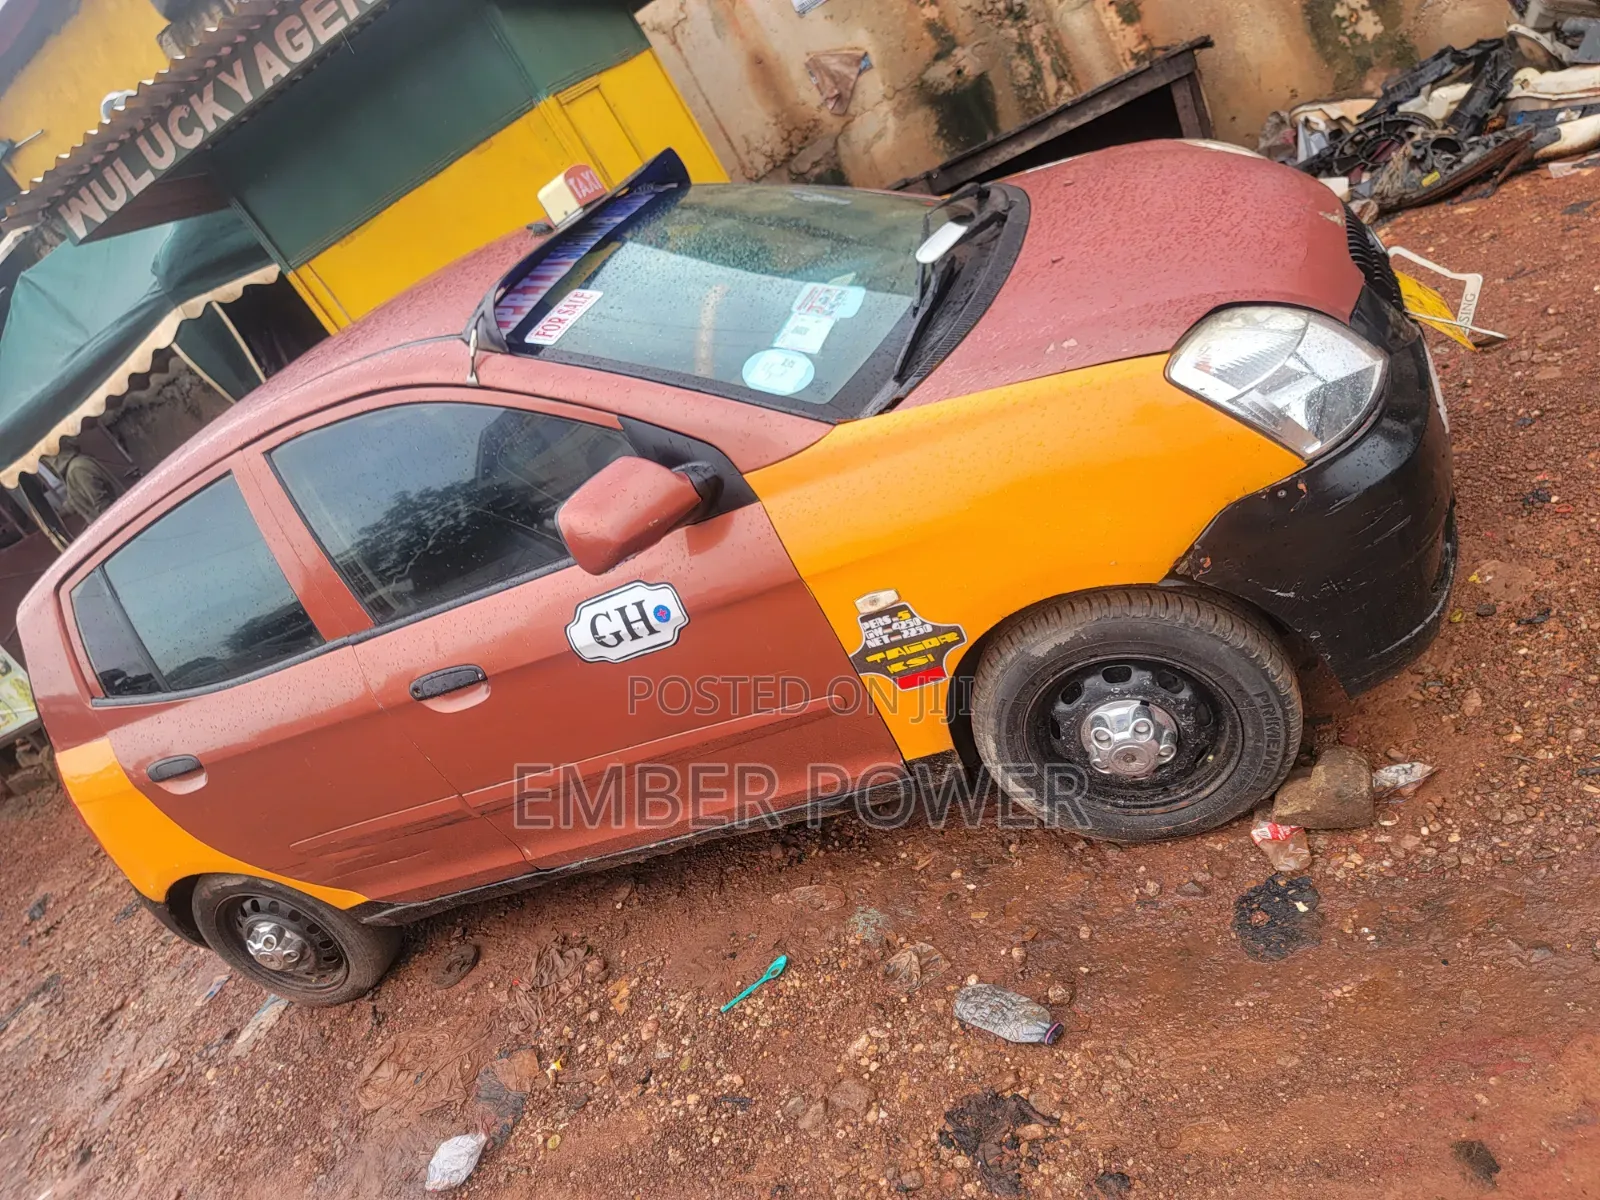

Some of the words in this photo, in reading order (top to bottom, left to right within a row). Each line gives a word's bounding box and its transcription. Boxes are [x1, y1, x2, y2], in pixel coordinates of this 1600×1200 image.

[568, 169, 604, 200] TAXI
[535, 316, 570, 338] FOR
[557, 291, 593, 316] SALE
[1459, 293, 1477, 325] SING
[589, 599, 661, 648] GH
